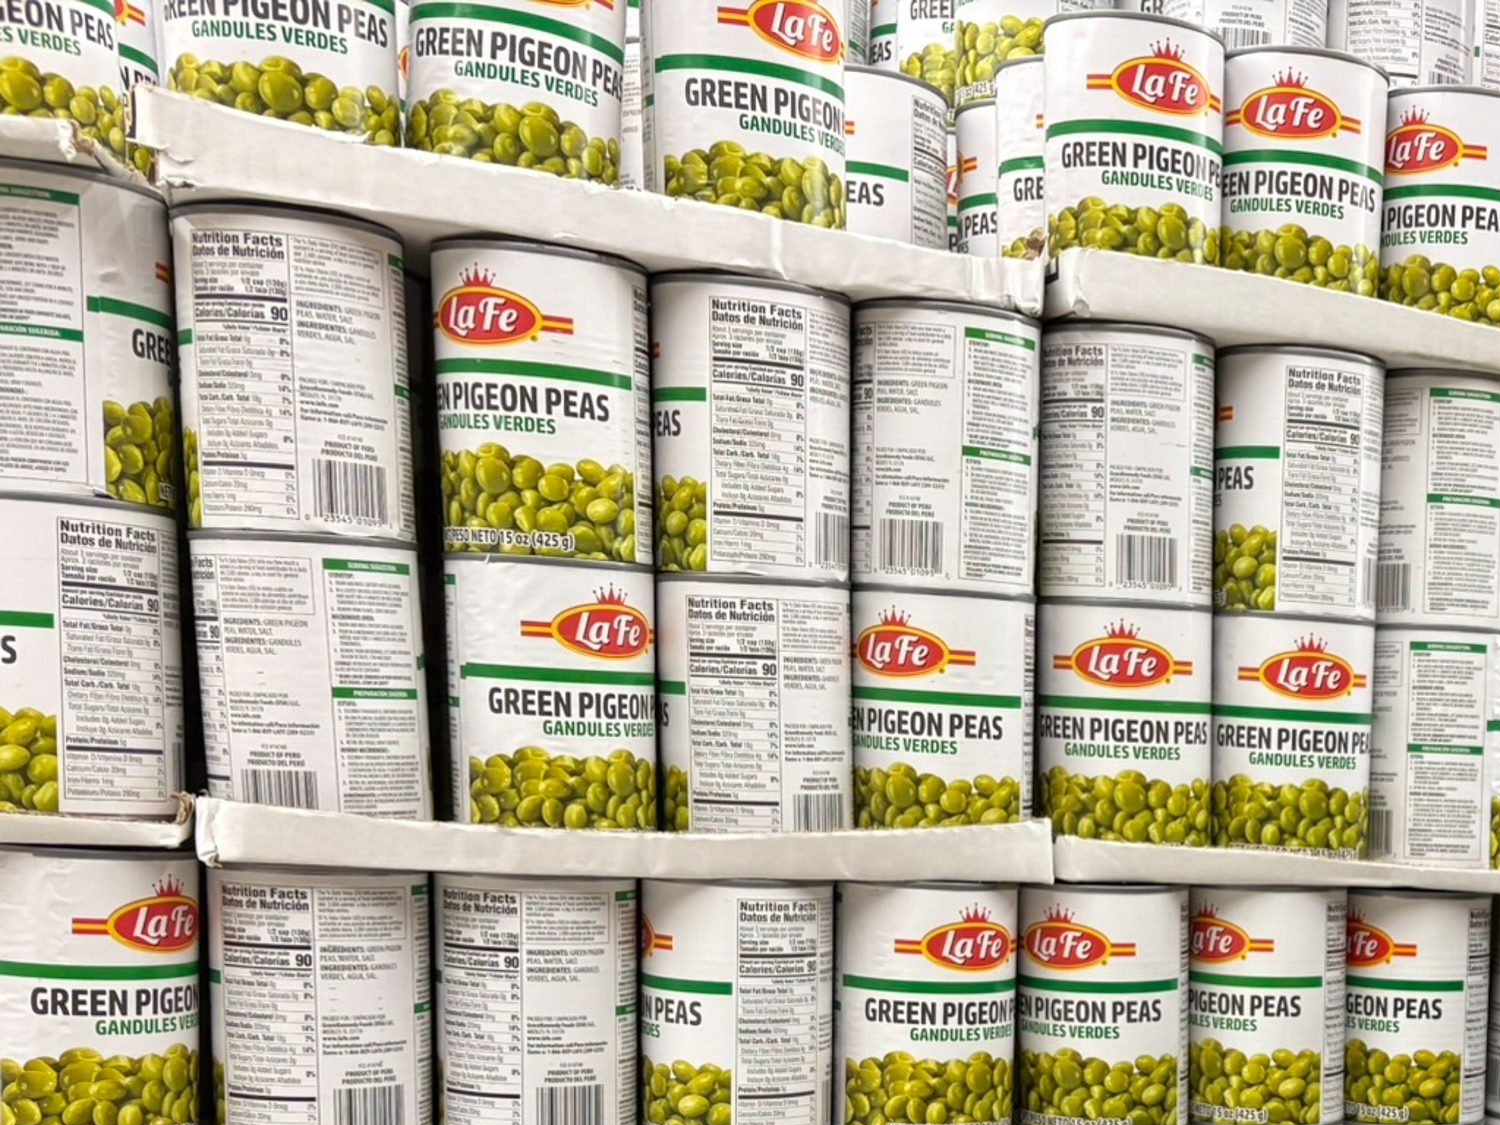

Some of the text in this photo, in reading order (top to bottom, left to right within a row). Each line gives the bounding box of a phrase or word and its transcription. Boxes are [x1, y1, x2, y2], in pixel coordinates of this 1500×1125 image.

[1254, 170, 1375, 216] PIGEON PEAS
[1230, 192, 1344, 220] GANDULES VERDES
[1396, 204, 1456, 230] PIGEON
[1419, 230, 1468, 245] VERDES
[452, 382, 609, 422] PIGEON PEAS
[493, 414, 556, 435] VERDES
[688, 597, 774, 611] Nutrition Facts
[688, 608, 775, 622] Datos de Nutrición
[762, 663, 777, 676] 90
[489, 687, 649, 720] GREEN PIGEON
[543, 720, 621, 737] GANDULES
[867, 707, 1002, 740] PIGEON PEAS
[903, 738, 958, 755] VERDES
[31, 987, 128, 1016] GREEN
[865, 998, 1007, 1025] GREEN PIGEON
[95, 1016, 177, 1035] GANDULES
[910, 1027, 981, 1042] GANDULES
